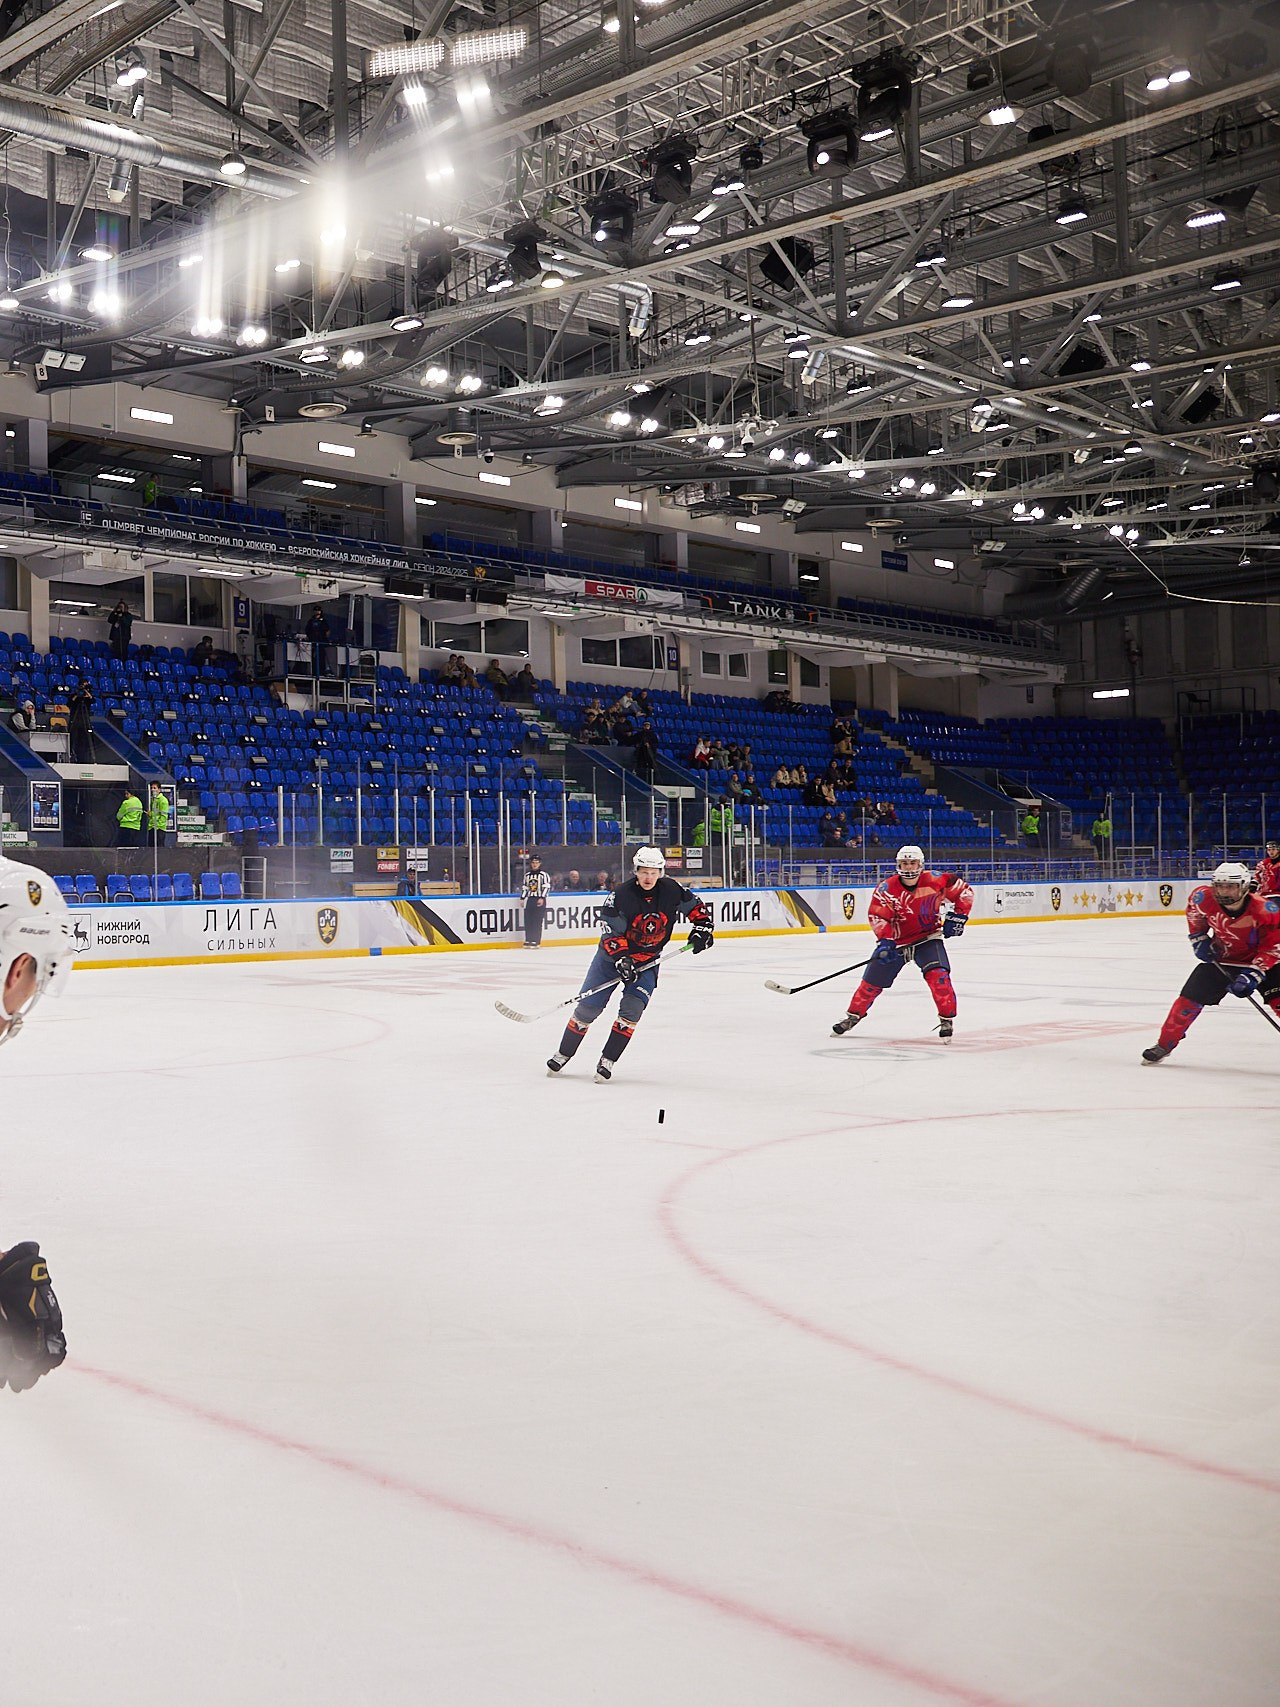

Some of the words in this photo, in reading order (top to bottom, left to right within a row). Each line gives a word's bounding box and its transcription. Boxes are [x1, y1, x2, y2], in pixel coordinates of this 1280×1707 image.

[39, 367, 44, 377] 8
[102, 519, 146, 534] OLIMPBET
[146, 525, 198, 541] ЧЕМПИОНАТ
[199, 533, 231, 545] РОССИИ
[232, 537, 243, 547] ПО
[246, 539, 277, 551] ХОККЕЮ
[288, 546, 349, 561] ВСЕРОССИЙСКАЯ
[350, 553, 391, 567] ХОККЕЙНАЯ
[392, 560, 409, 569] ЛИГА
[413, 562, 434, 573] СЕЗОН
[596, 585, 636, 600] SPAR
[238, 602, 246, 617] 9
[728, 599, 782, 621] TANK
[668, 649, 677, 661] 10
[377, 863, 400, 871] FONBET
[720, 900, 761, 922] ЛИГА
[97, 918, 141, 932] НИЖНИЙ
[202, 907, 278, 933] ЛИГА
[466, 905, 604, 936] ОФИЦРСКАЯ
[19, 927, 51, 936] BAUER
[97, 934, 151, 946] НОВГОРОД
[207, 937, 277, 952] СИЛЬНЫХ
